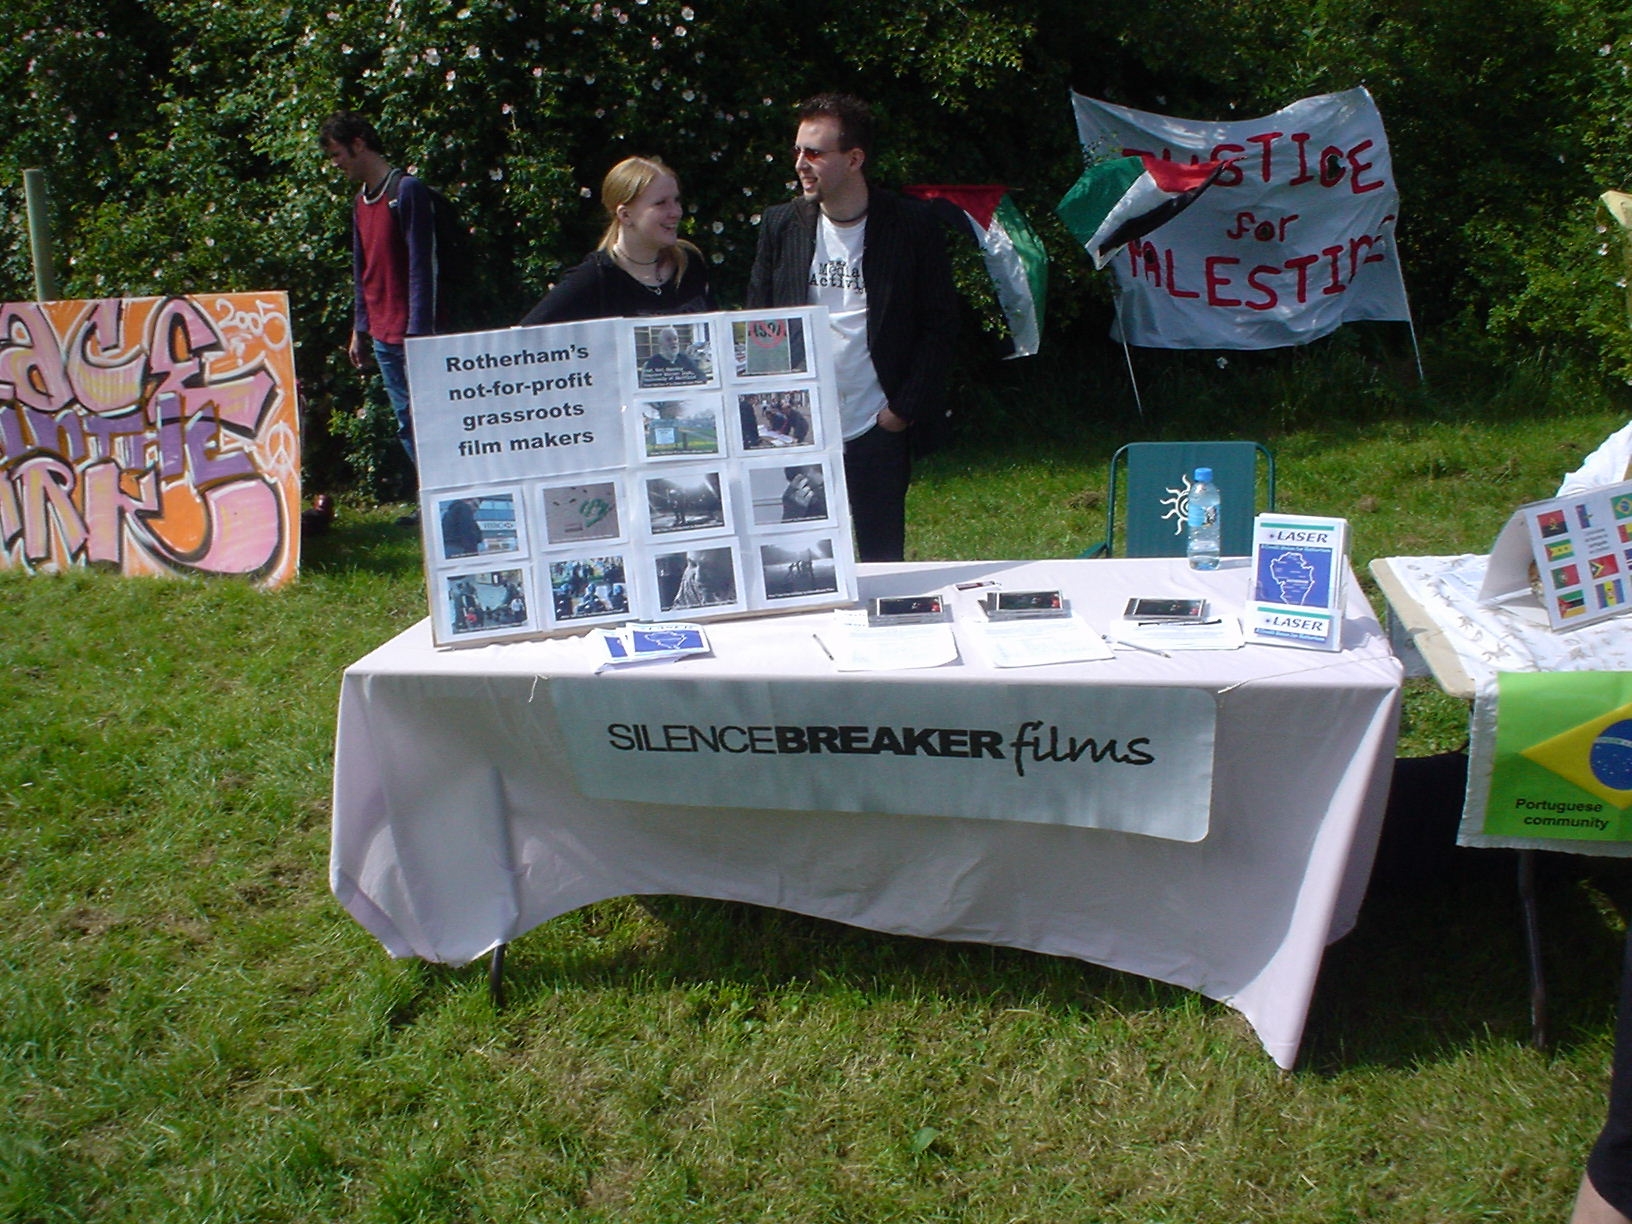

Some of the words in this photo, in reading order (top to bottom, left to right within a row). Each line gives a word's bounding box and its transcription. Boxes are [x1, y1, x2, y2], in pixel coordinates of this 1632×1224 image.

[1121, 132, 1385, 194] STICE
[1226, 212, 1299, 242] for
[215, 297, 291, 351] 2005
[445, 344, 590, 373] Rotherham's
[449, 371, 594, 401] not-for-profit
[462, 402, 585, 432] grassroots
[458, 440, 503, 457] film
[509, 430, 595, 452] makers
[1277, 531, 1328, 543] LASER
[1272, 616, 1323, 631] LASER
[608, 723, 1005, 760] SILENCEBREAKER
[1010, 720, 1155, 777] films
[1515, 799, 1603, 813] Portuguese
[1523, 816, 1609, 830] community
